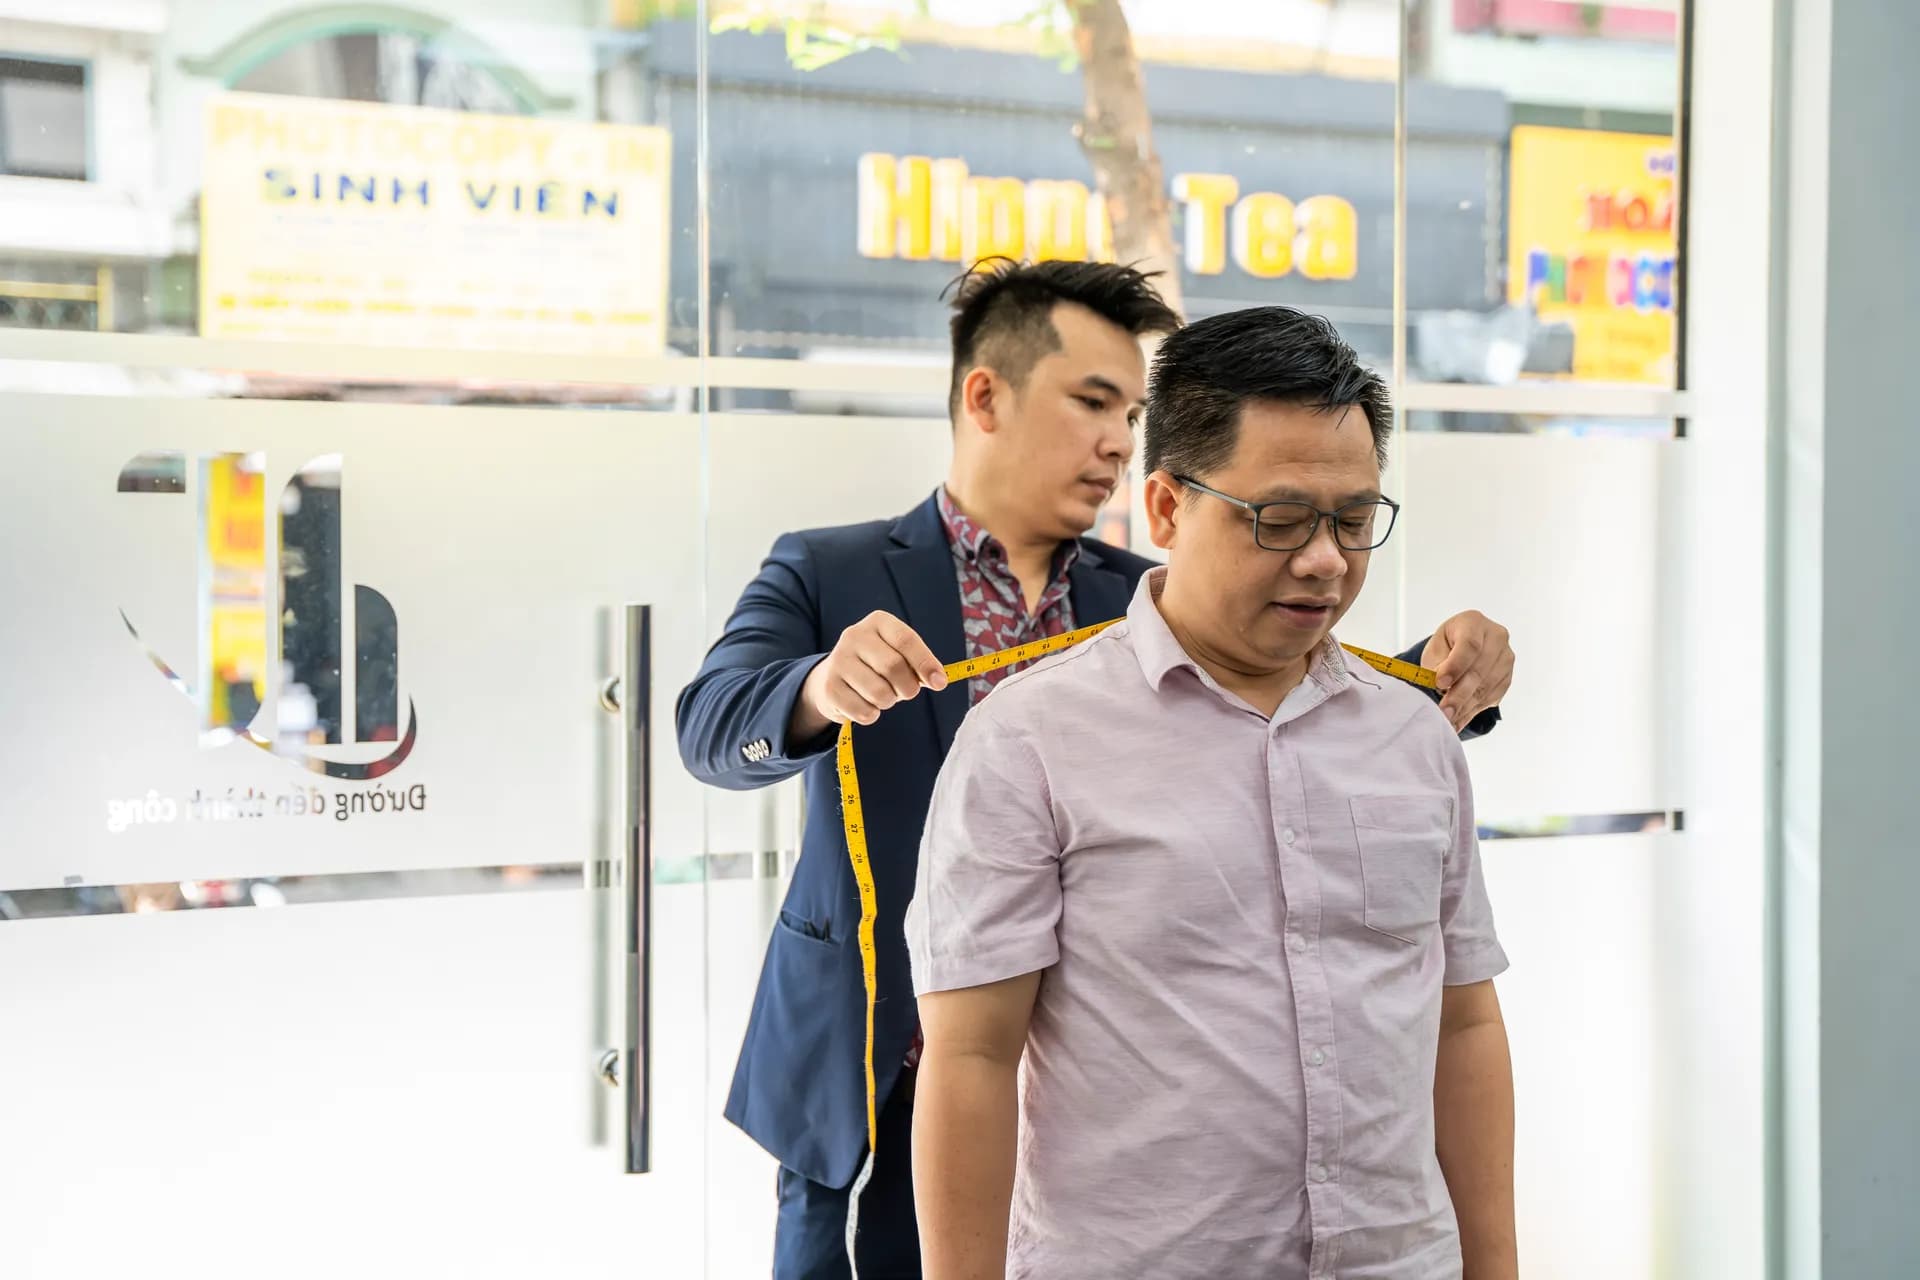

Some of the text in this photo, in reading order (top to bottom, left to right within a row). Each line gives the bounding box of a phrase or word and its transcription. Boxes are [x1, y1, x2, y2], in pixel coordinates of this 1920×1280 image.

[263, 168, 429, 207] SINH
[1172, 172, 1358, 280] Tea
[843, 764, 851, 775] 25
[847, 794, 855, 805] 26
[850, 823, 858, 834] 27
